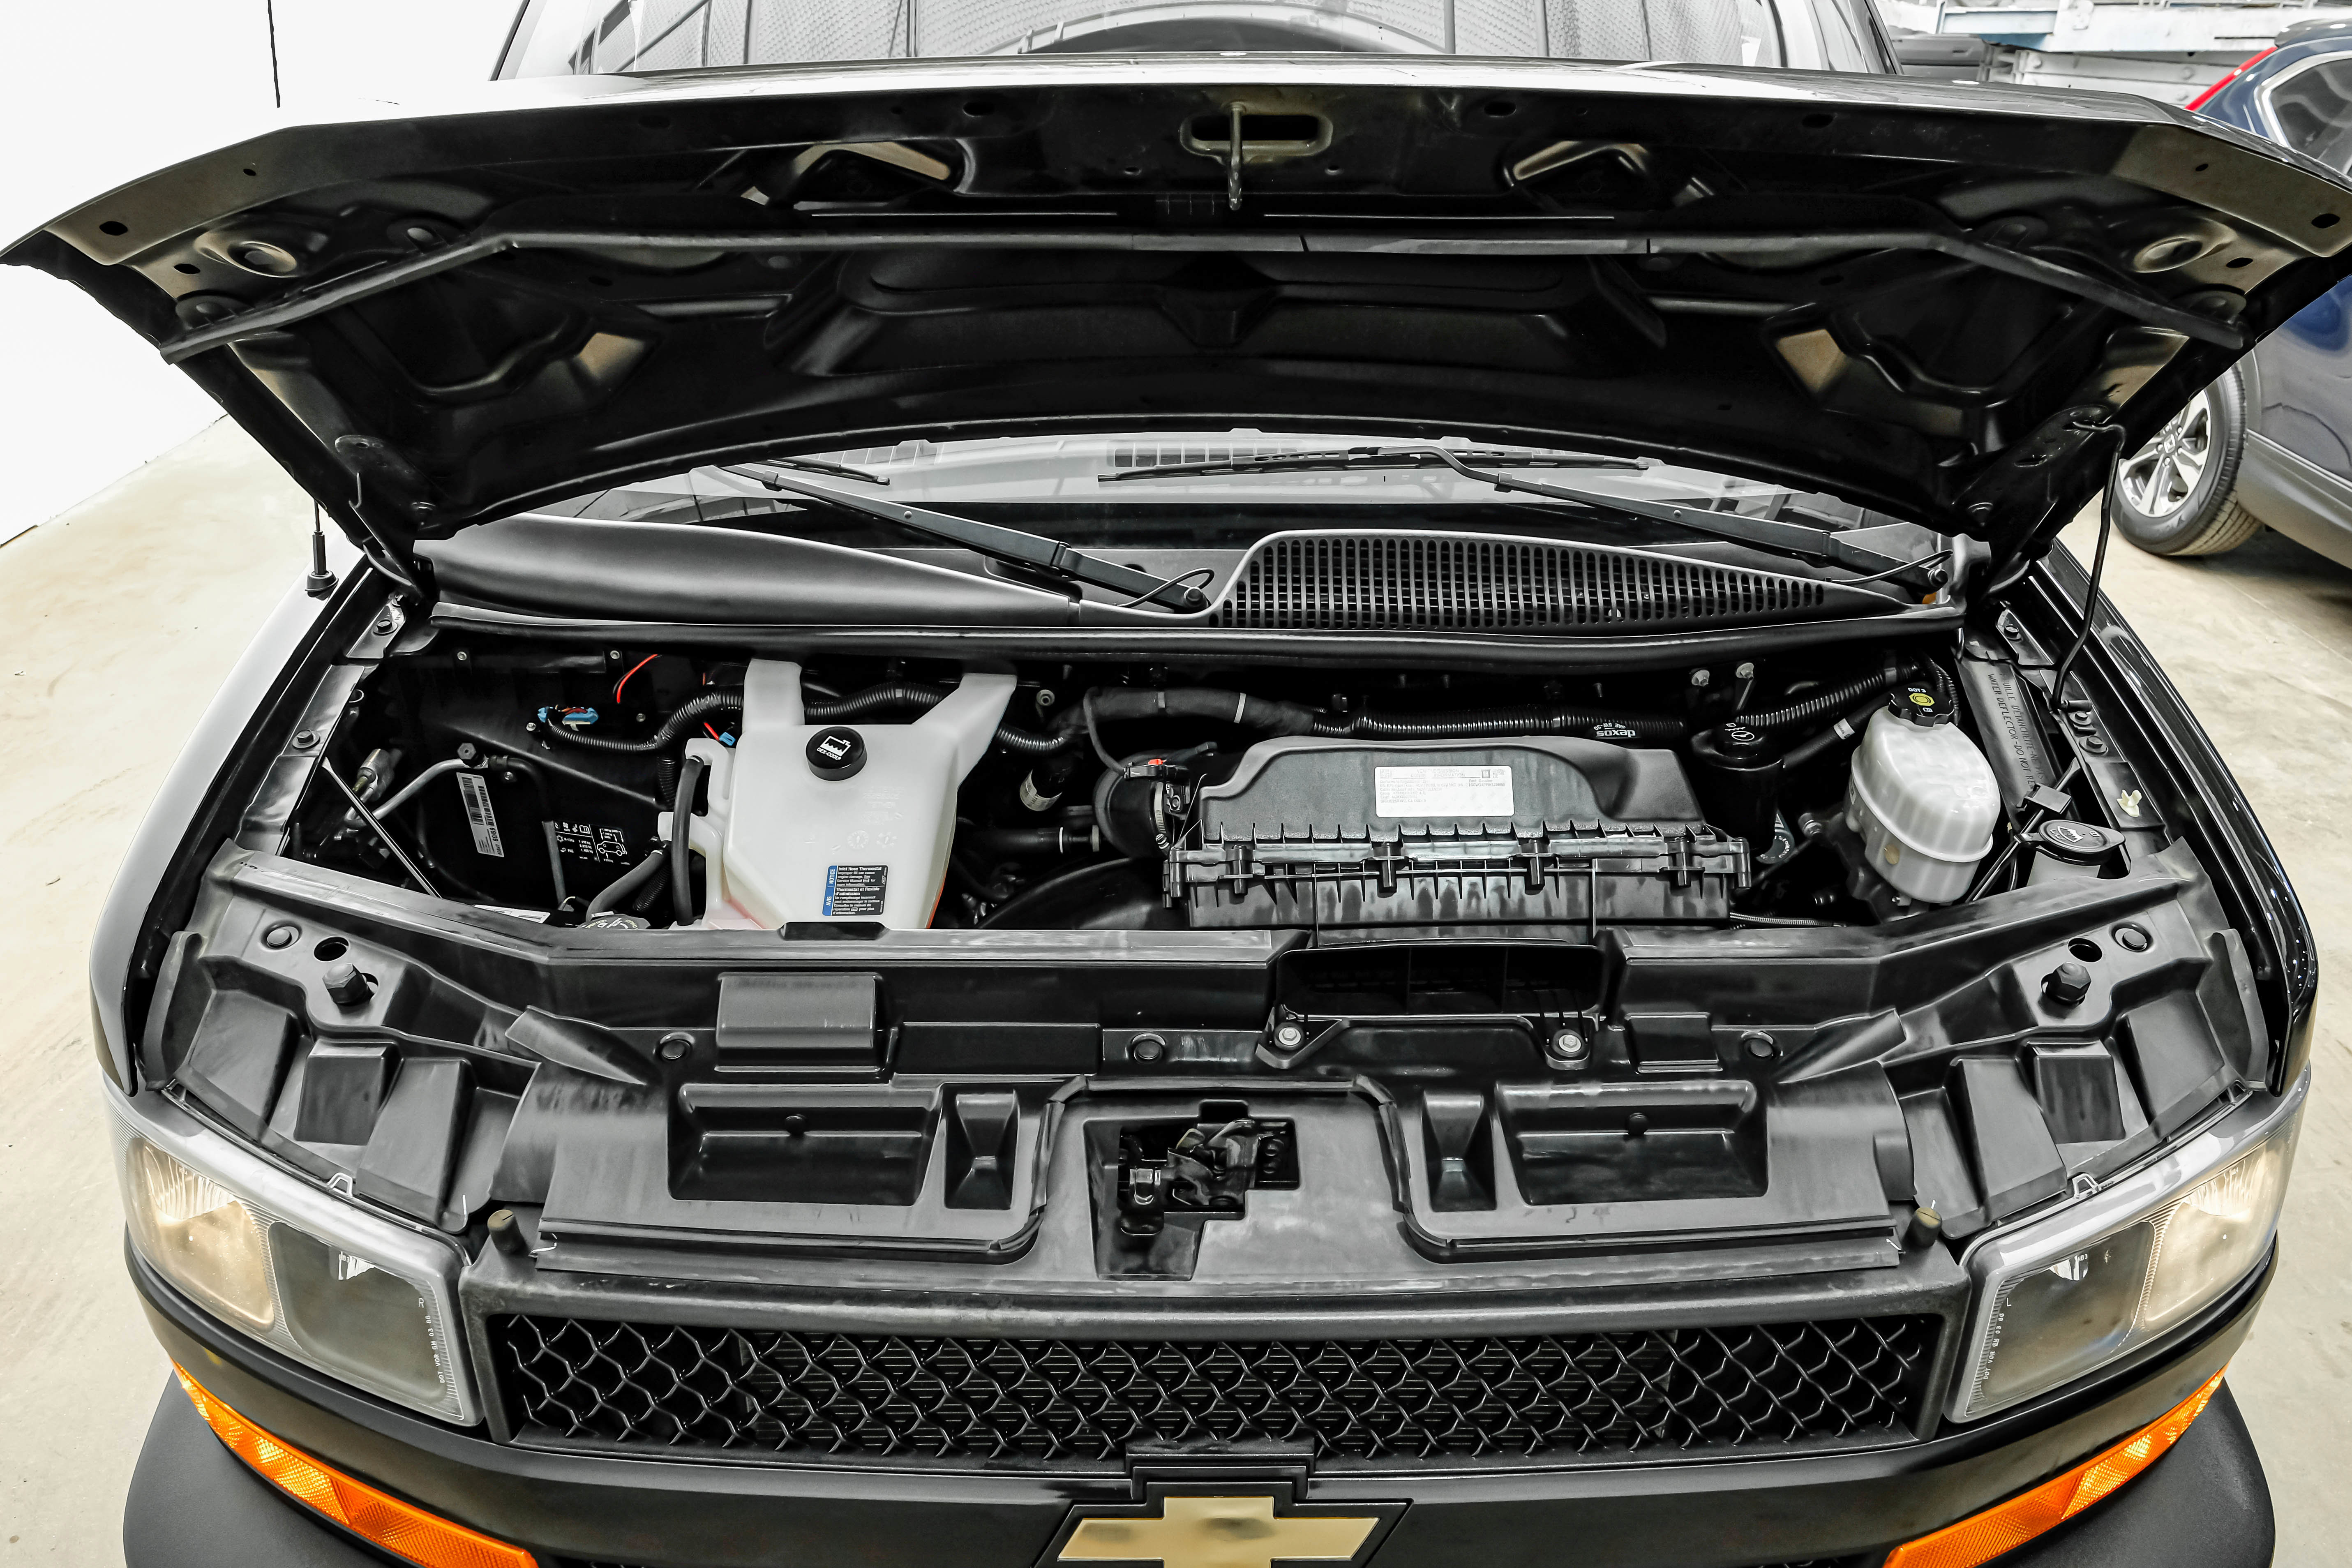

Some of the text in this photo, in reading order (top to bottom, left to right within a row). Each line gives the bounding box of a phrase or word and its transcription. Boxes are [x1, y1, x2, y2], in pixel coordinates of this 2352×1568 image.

[1988, 673, 2002, 695] WATER
[2019, 757, 2031, 772] NOT
[489, 827, 499, 842] 60/69
[418, 1298, 424, 1308] R
[2007, 1298, 2012, 1307] L
[428, 1328, 434, 1337] 03
[431, 1341, 438, 1350] GM
